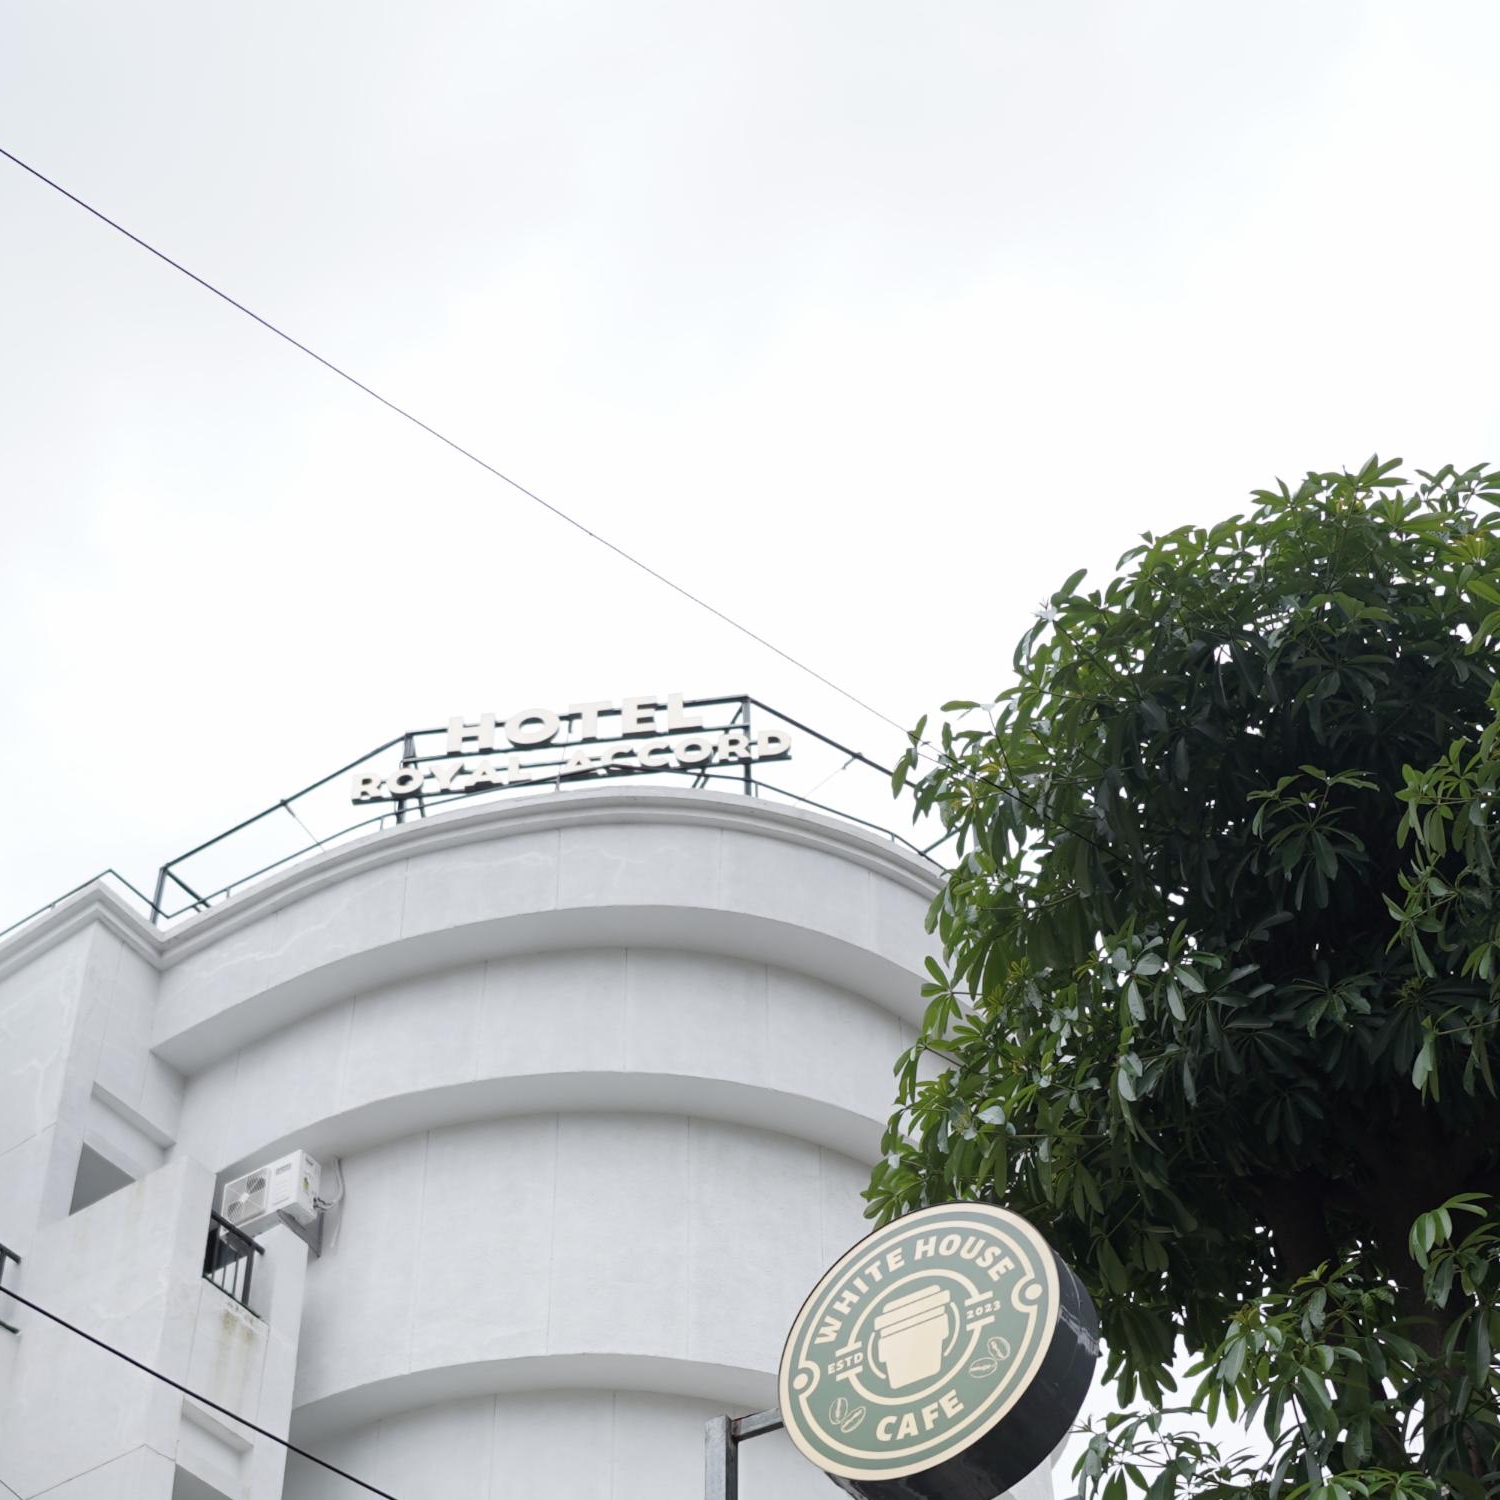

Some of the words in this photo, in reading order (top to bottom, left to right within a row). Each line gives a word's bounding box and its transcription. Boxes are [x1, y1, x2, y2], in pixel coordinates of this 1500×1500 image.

[446, 693, 703, 755] HOTEL
[350, 757, 532, 801] ROYAL
[563, 730, 792, 776] ACCORD
[814, 1247, 906, 1345] WHITE
[914, 1233, 1015, 1282] HOUSE
[966, 1301, 1001, 1320] 2023
[827, 1351, 864, 1375] ESTD
[875, 1389, 965, 1442] CAFE
